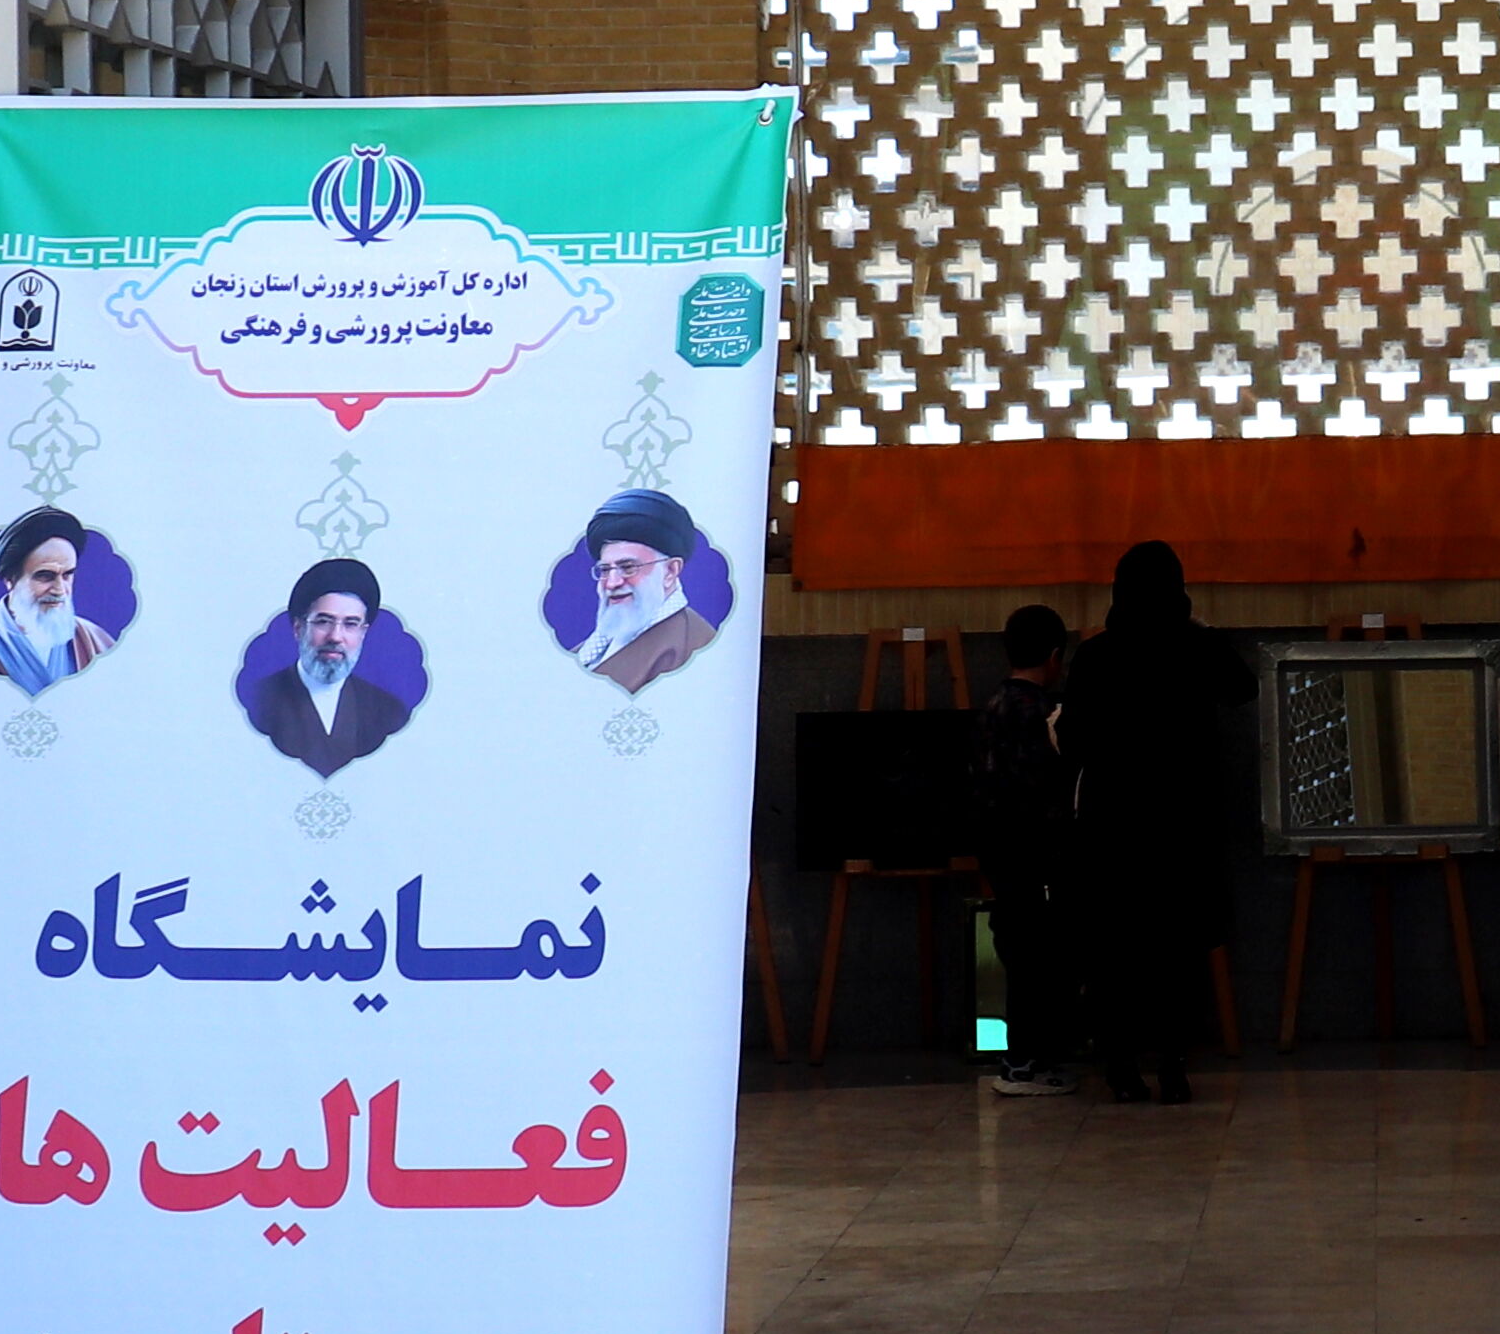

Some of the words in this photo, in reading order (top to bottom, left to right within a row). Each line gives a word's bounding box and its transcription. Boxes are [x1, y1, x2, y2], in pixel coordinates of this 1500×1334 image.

[191, 274, 245, 298] زنجان
[249, 274, 298, 297] استان
[302, 273, 364, 297] پرورش
[368, 280, 377, 297] و
[381, 270, 449, 297] آموزش
[452, 272, 480, 296] کل
[483, 272, 527, 296] اداره
[221, 312, 307, 344] فرهنگی
[311, 324, 322, 344] و
[326, 315, 412, 344] پرورشی
[415, 313, 493, 343] معاونت
[10, 357, 53, 372] پرورشی
[57, 358, 96, 372] معاونت
[35, 871, 607, 1014] نمایشگاه
[139, 1067, 628, 1247] فعالیت
